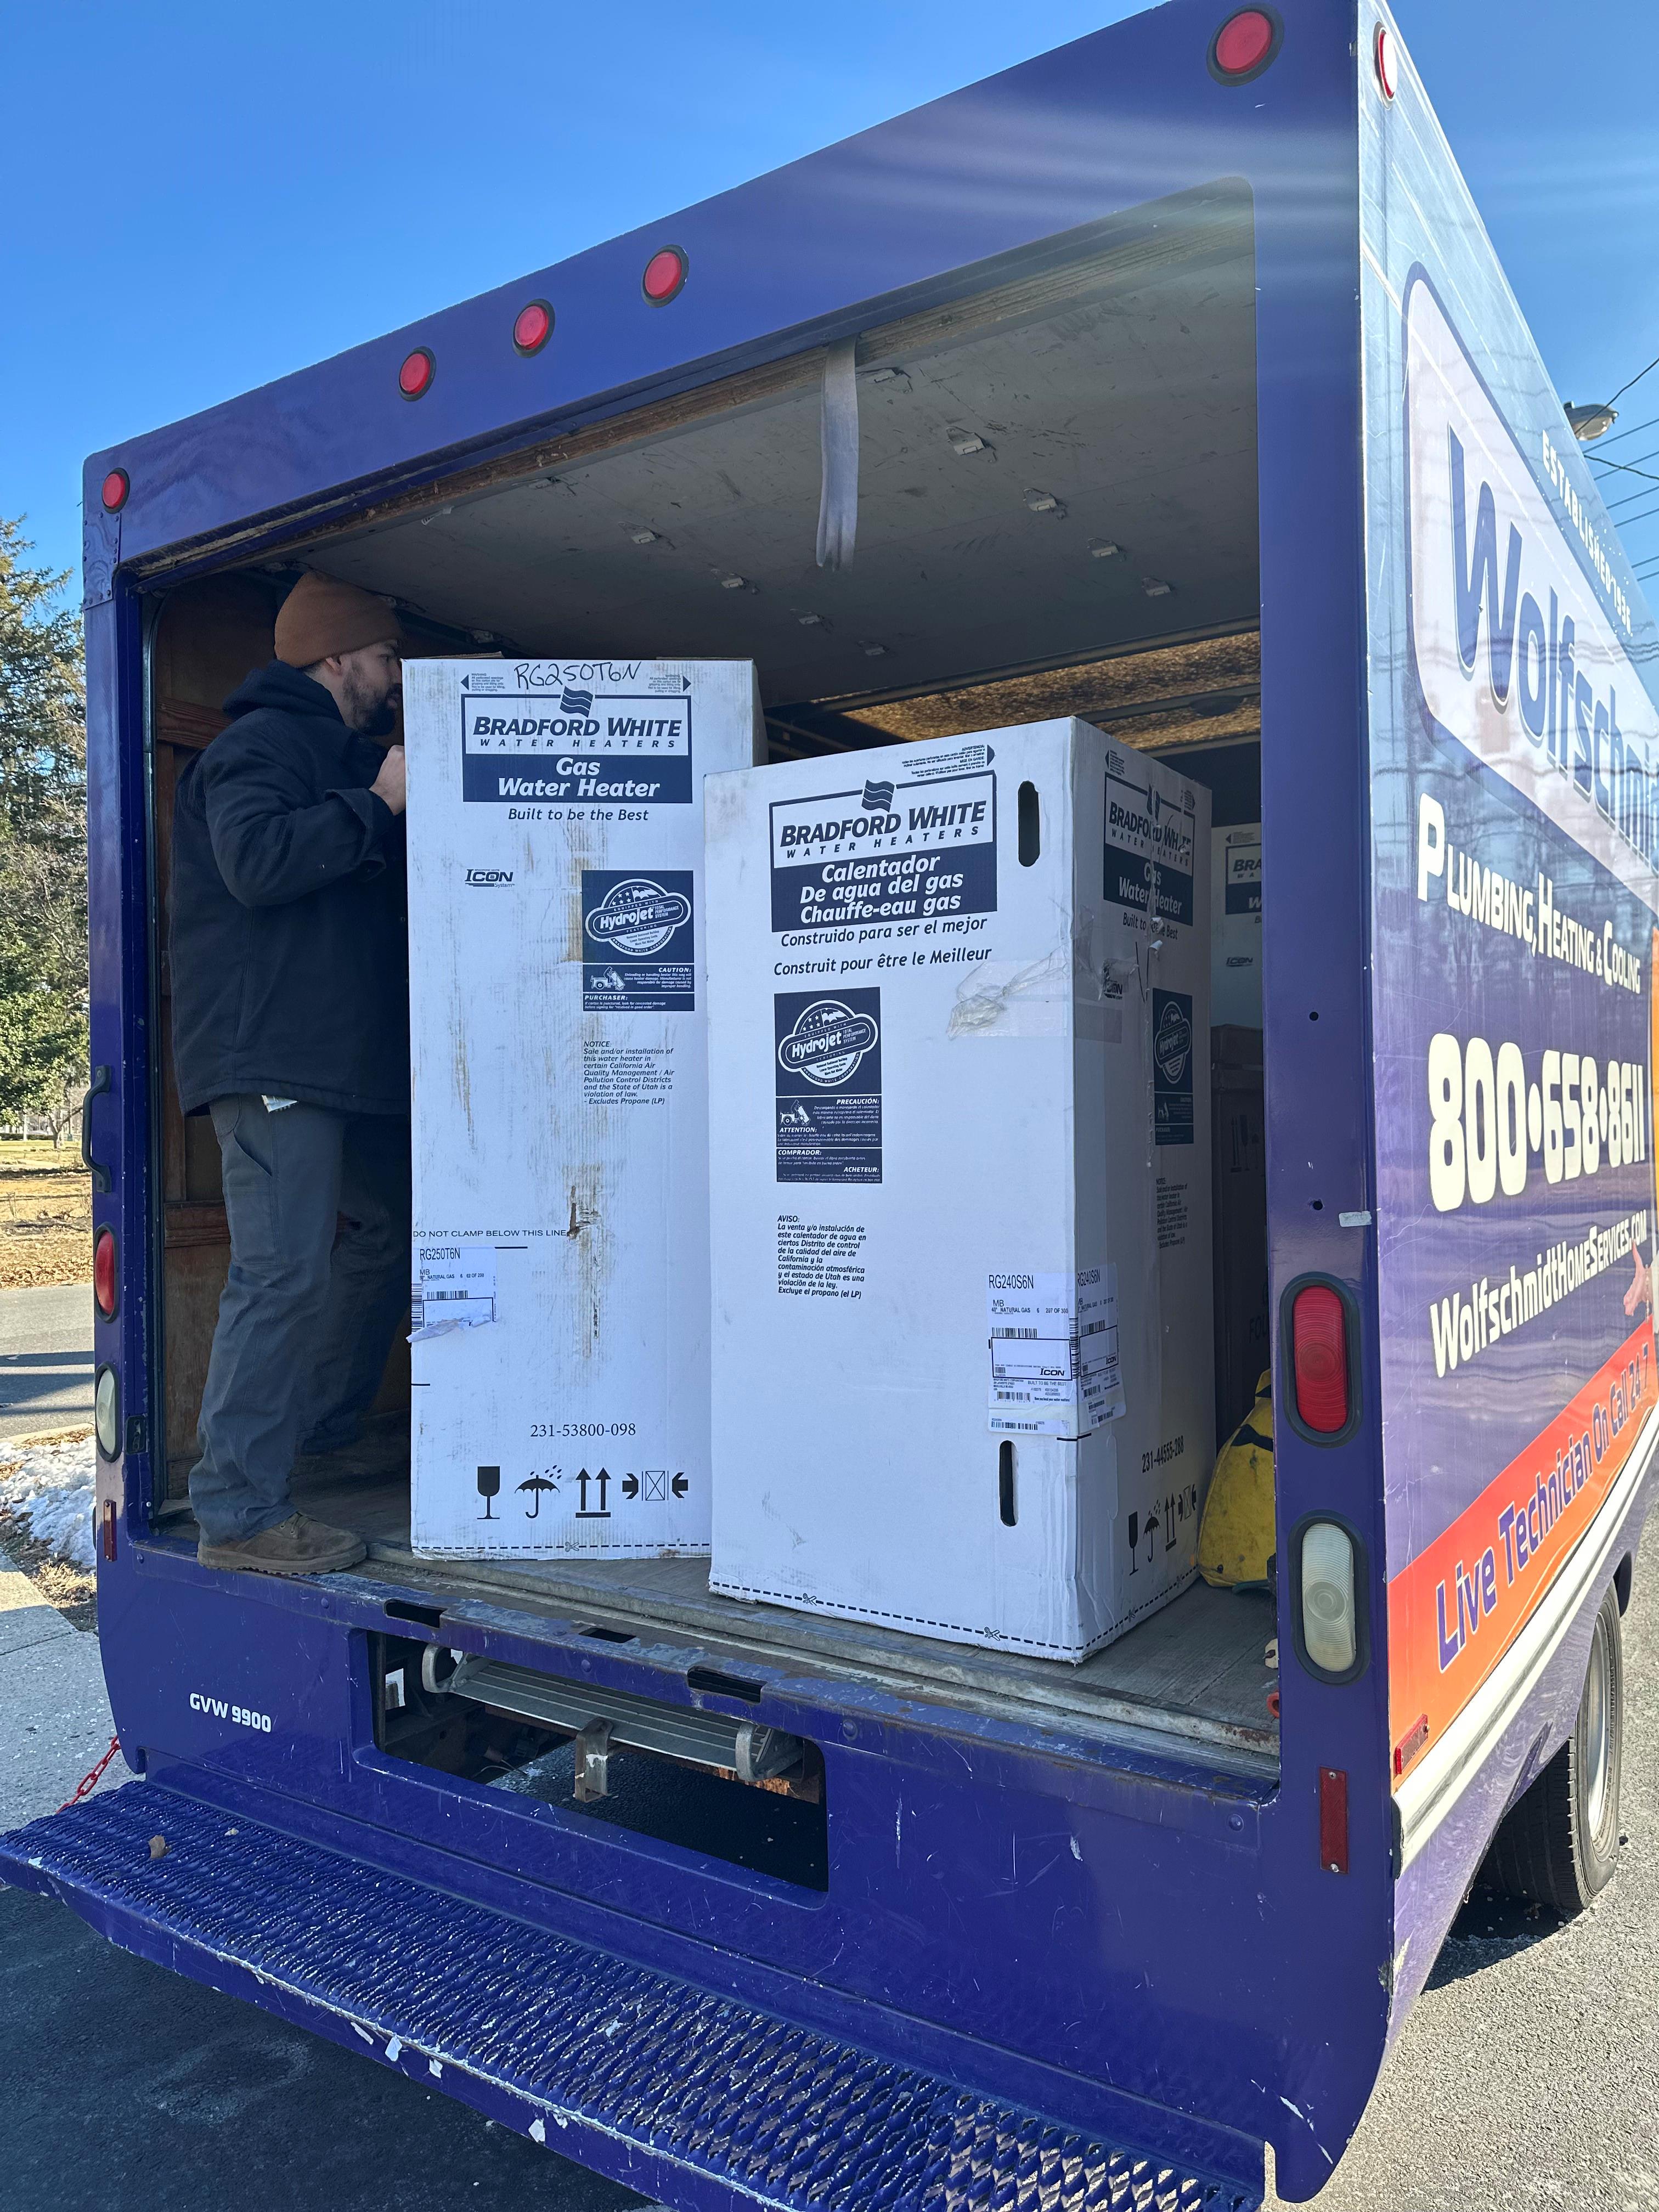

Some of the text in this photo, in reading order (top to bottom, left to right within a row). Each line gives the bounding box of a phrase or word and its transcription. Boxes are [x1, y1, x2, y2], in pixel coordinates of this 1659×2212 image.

[1542, 430, 1611, 594] ESTABLISHED
[514, 662, 642, 690] RG250T6N
[473, 716, 682, 737] BRADFORD WHITE
[480, 738, 676, 748] WATER HEATERS
[556, 757, 601, 776] Gas
[498, 777, 661, 797] Water Heater
[508, 808, 650, 821] Built to be the Best
[780, 800, 987, 848] BRADFORD WHITE
[787, 826, 979, 859] WATER HEATERS
[1111, 828, 1144, 848] WATER
[1164, 825, 1191, 856] WHTE
[464, 868, 514, 882] ICON
[822, 854, 941, 883] Calentador
[800, 871, 964, 904] De agua del gas
[1119, 877, 1182, 915] Water Heater
[1417, 793, 1641, 995] PLUMBING, HEATING & COOLING
[600, 907, 653, 930] Hydrojet
[800, 894, 962, 924] Chauffe-eau gas
[781, 917, 988, 947] Construido para ser el mejor
[1123, 912, 1138, 929] Built
[1140, 919, 1147, 931] to
[1166, 924, 1179, 940] Best
[774, 947, 992, 976] Construit pour être le Meilleur
[792, 1031, 843, 1059] Hydrojet
[777, 1215, 800, 1223] AVISO:
[420, 1247, 461, 1261] RG250T6N
[826, 1265, 865, 1274] atmosférica
[989, 1274, 1034, 1289] RG240S6N
[778, 1286, 803, 1295] Excluye
[811, 1289, 839, 1297] propano
[840, 1290, 849, 1299] (el
[851, 1290, 862, 1300] LP)
[992, 1299, 1005, 1307] MB
[1040, 1368, 1065, 1377] ICON
[530, 1423, 636, 1437] 231-53800-098
[1436, 1546, 1498, 1674] Live
[1497, 1431, 1593, 1589] Technician
[1592, 1402, 1610, 1465] On
[1610, 1369, 1629, 1439] Call
[189, 1692, 272, 1733] GVW 9900
